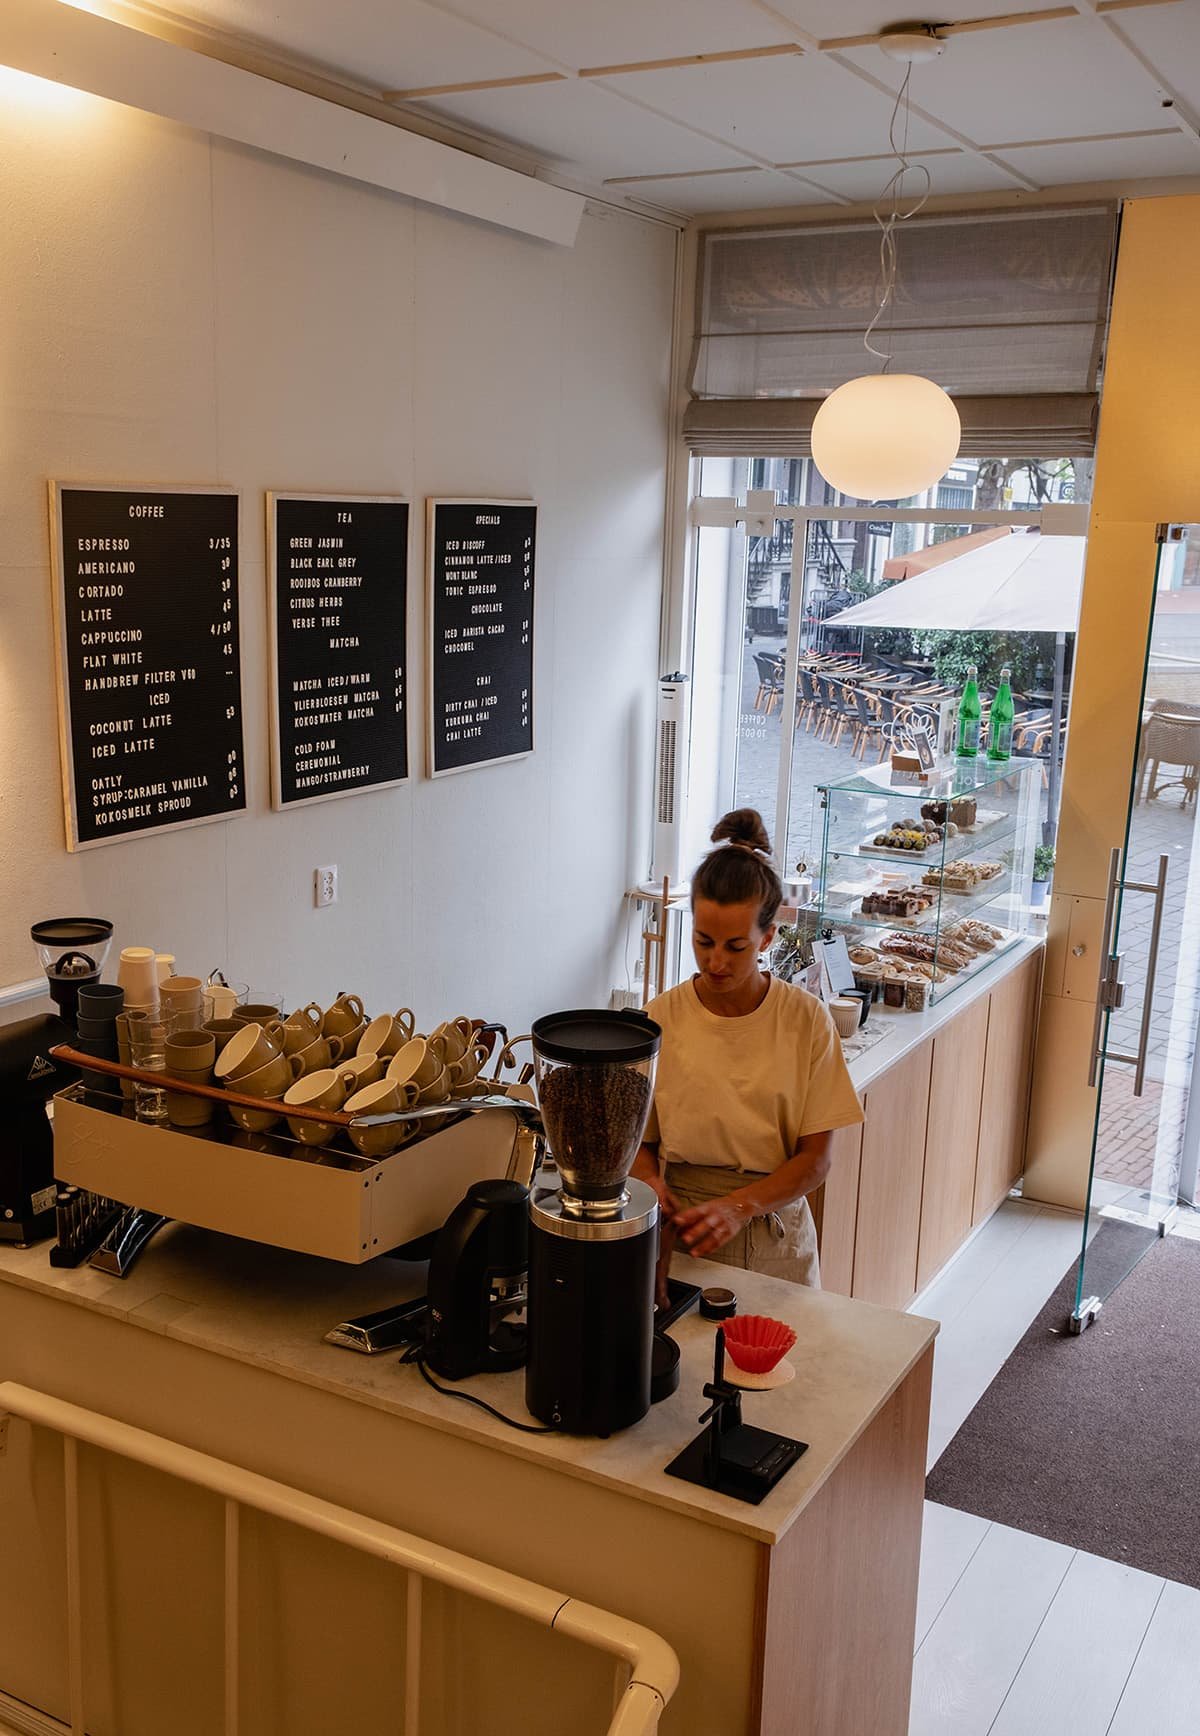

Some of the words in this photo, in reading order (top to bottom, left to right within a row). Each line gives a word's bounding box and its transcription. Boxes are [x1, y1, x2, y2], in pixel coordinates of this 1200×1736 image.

[129, 506, 163, 517] COFFEE
[338, 513, 352, 522] TEA
[476, 516, 500, 524] SPECIALS
[79, 539, 129, 551] ESPRESSO
[210, 538, 230, 549] 3/35
[290, 538, 312, 548] GREEN
[318, 538, 343, 548] JASMIN
[446, 541, 459, 550] ICED
[463, 541, 485, 550] BISCOFF
[291, 558, 312, 568] BLACK
[317, 558, 334, 567] EARL
[338, 558, 356, 567] GREY
[445, 556, 473, 565] CINNAMON
[78, 562, 135, 574] AMERICANO
[446, 571, 460, 580] MONT
[462, 571, 477, 580] BLANC
[291, 578, 320, 588] ROOIBOS
[324, 577, 362, 587] CRANBERRY
[79, 585, 123, 598] CORTADO
[446, 587, 463, 596] TONIC
[469, 584, 496, 595] ESPRESSO
[290, 598, 314, 608] CITRUS
[319, 597, 342, 607] HERBS
[471, 603, 502, 614] CHOCOLATE
[81, 609, 111, 621] LATTE
[292, 618, 315, 628] VERSE
[321, 616, 339, 627] THEE
[445, 629, 457, 638] ICED
[463, 627, 484, 637] BARISTA
[488, 624, 504, 634] CACAO
[82, 630, 142, 645] CAPPUCCINO
[330, 637, 359, 648] MATCHA
[445, 642, 474, 653] CHOCOMEL
[84, 655, 106, 668] FLAT
[112, 652, 142, 664] WHITE
[224, 644, 232, 655] 45
[85, 674, 138, 690] HANDBREW
[145, 671, 175, 684] FILTER
[181, 669, 195, 680] V60
[293, 679, 321, 691] MATCHA
[328, 673, 370, 687] ICED/WARM
[477, 676, 490, 686] CHAI
[150, 693, 169, 705] ICED
[294, 695, 350, 713] VLIERBLOESEM
[354, 691, 379, 702] MATCHA
[446, 702, 462, 712] DIRTY
[464, 699, 477, 709] CHAI
[295, 710, 342, 727] KOKOSWATER
[348, 707, 374, 719] MATCHA
[476, 712, 489, 722] CHAI
[90, 720, 133, 736] COCONUT
[143, 714, 171, 728] LATTE
[446, 731, 460, 741] CHAI
[464, 727, 481, 738] LATTE
[93, 744, 115, 758] ICED
[125, 738, 154, 753] LATTE
[295, 743, 312, 755] COLD
[316, 740, 335, 752] FOAM
[296, 754, 343, 773] CEREMONIAL
[92, 775, 121, 790] OATLY
[296, 764, 371, 790] MANGO/STRAWBERRY
[172, 776, 208, 791] VANILLA
[94, 803, 151, 825] KOKOSMELK
[158, 797, 190, 813] SPROUD
